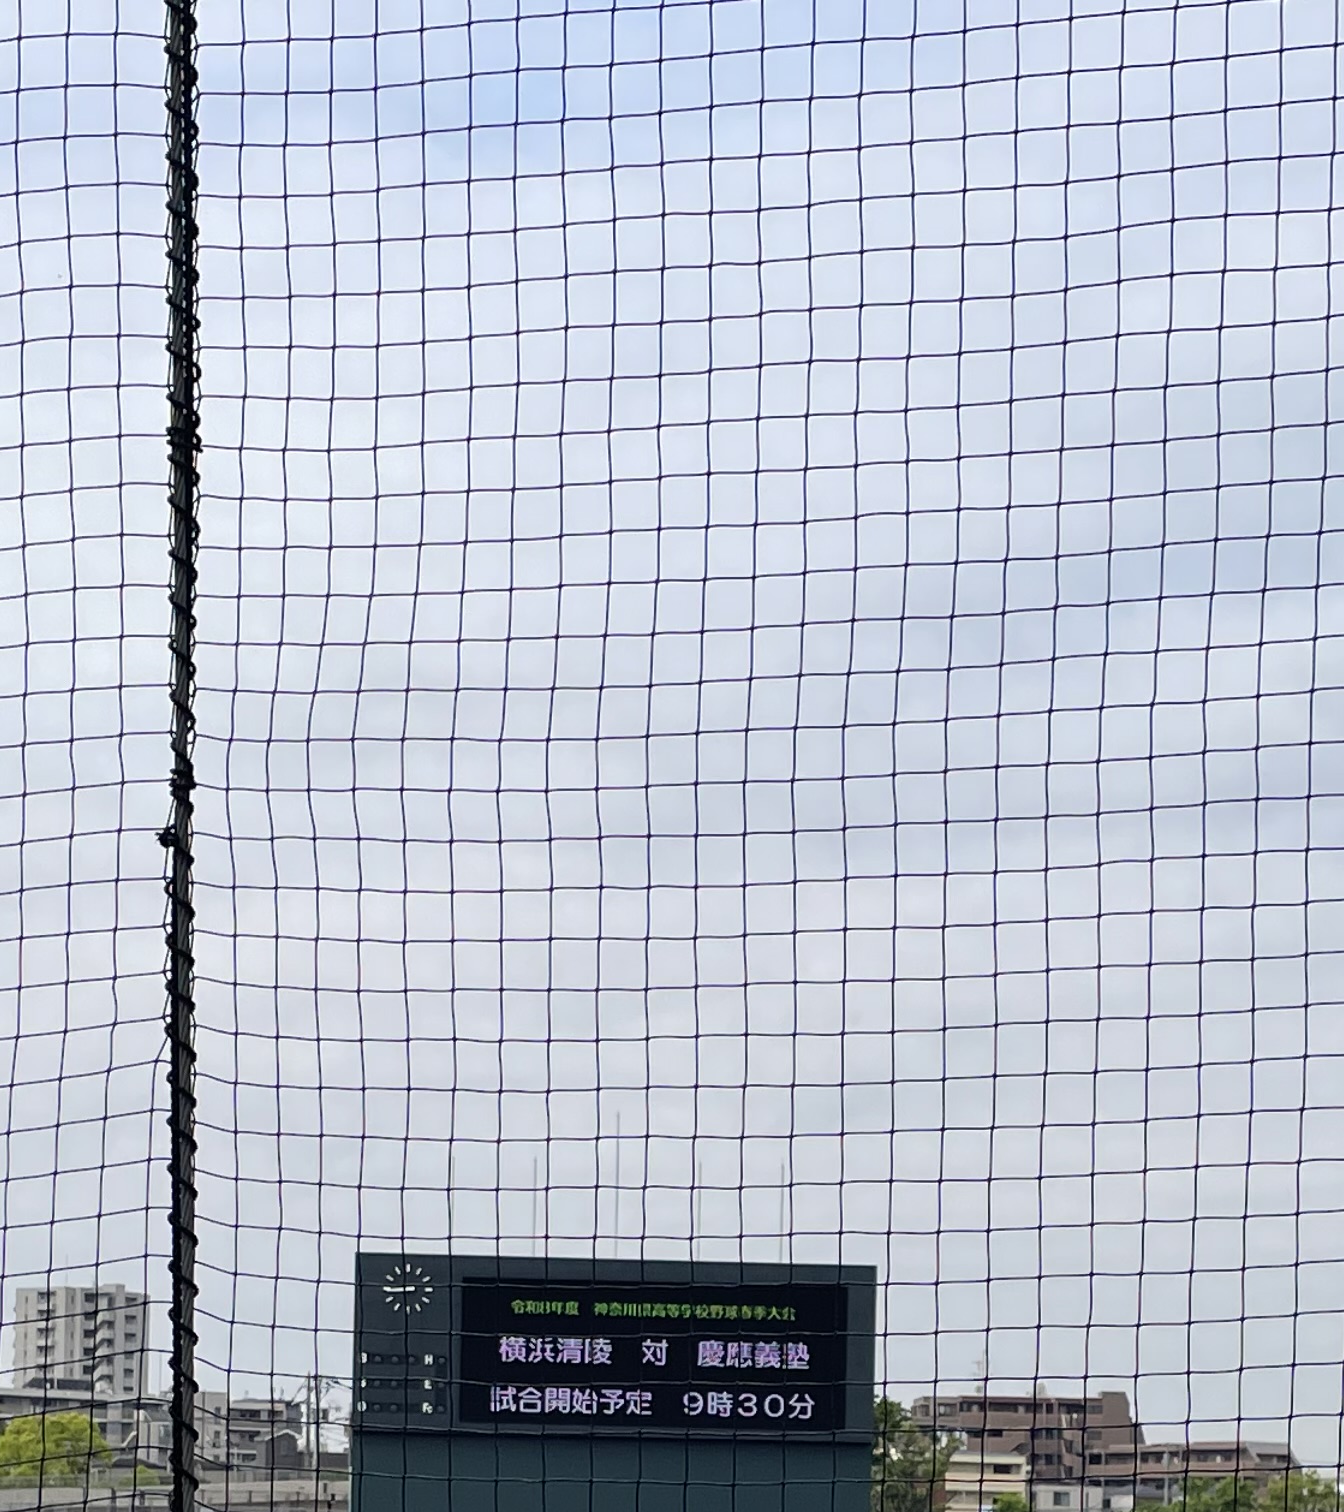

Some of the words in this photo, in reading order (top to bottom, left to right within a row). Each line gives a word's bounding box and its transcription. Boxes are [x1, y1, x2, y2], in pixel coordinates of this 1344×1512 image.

[424, 1354, 434, 1365] H
[498, 1336, 613, 1364] 横浜清陵
[641, 1339, 669, 1366] 対
[697, 1340, 810, 1369] 慶應義塾
[490, 1386, 653, 1415] 試合開始予定
[683, 1391, 815, 1419] 9時30分
